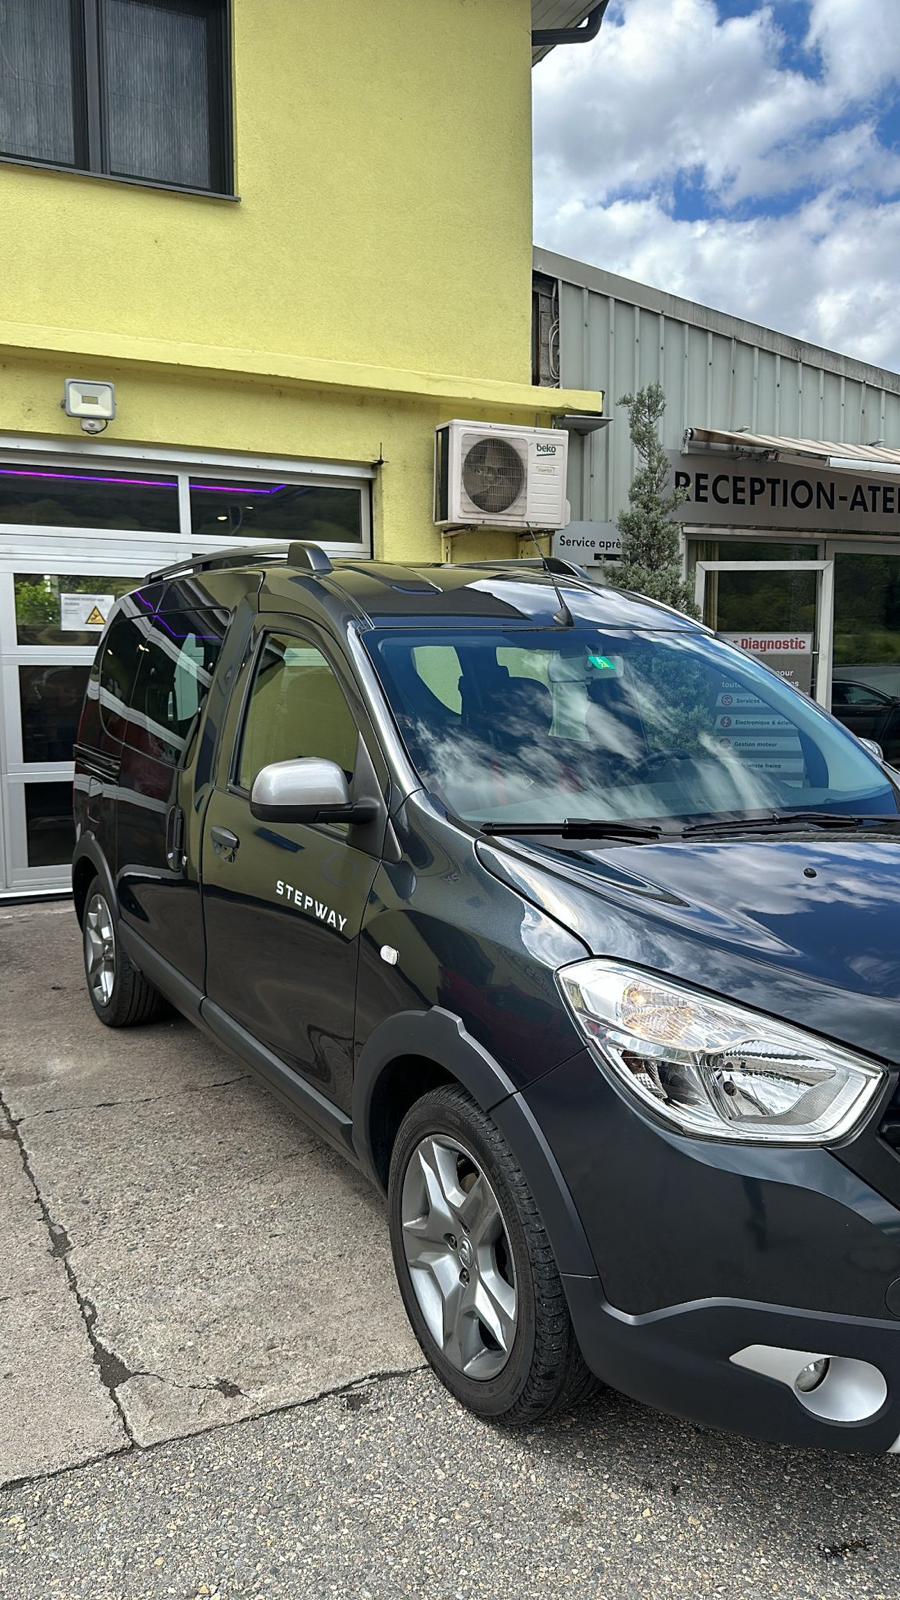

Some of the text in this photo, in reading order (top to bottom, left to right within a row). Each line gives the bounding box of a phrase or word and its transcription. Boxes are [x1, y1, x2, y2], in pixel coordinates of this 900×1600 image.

[536, 443, 557, 453] beko
[674, 471, 900, 514] RECEPTION-ATE
[559, 535, 622, 551] Service aprè
[740, 637, 806, 653] Diagnostic
[275, 880, 348, 932] STEPWAY
